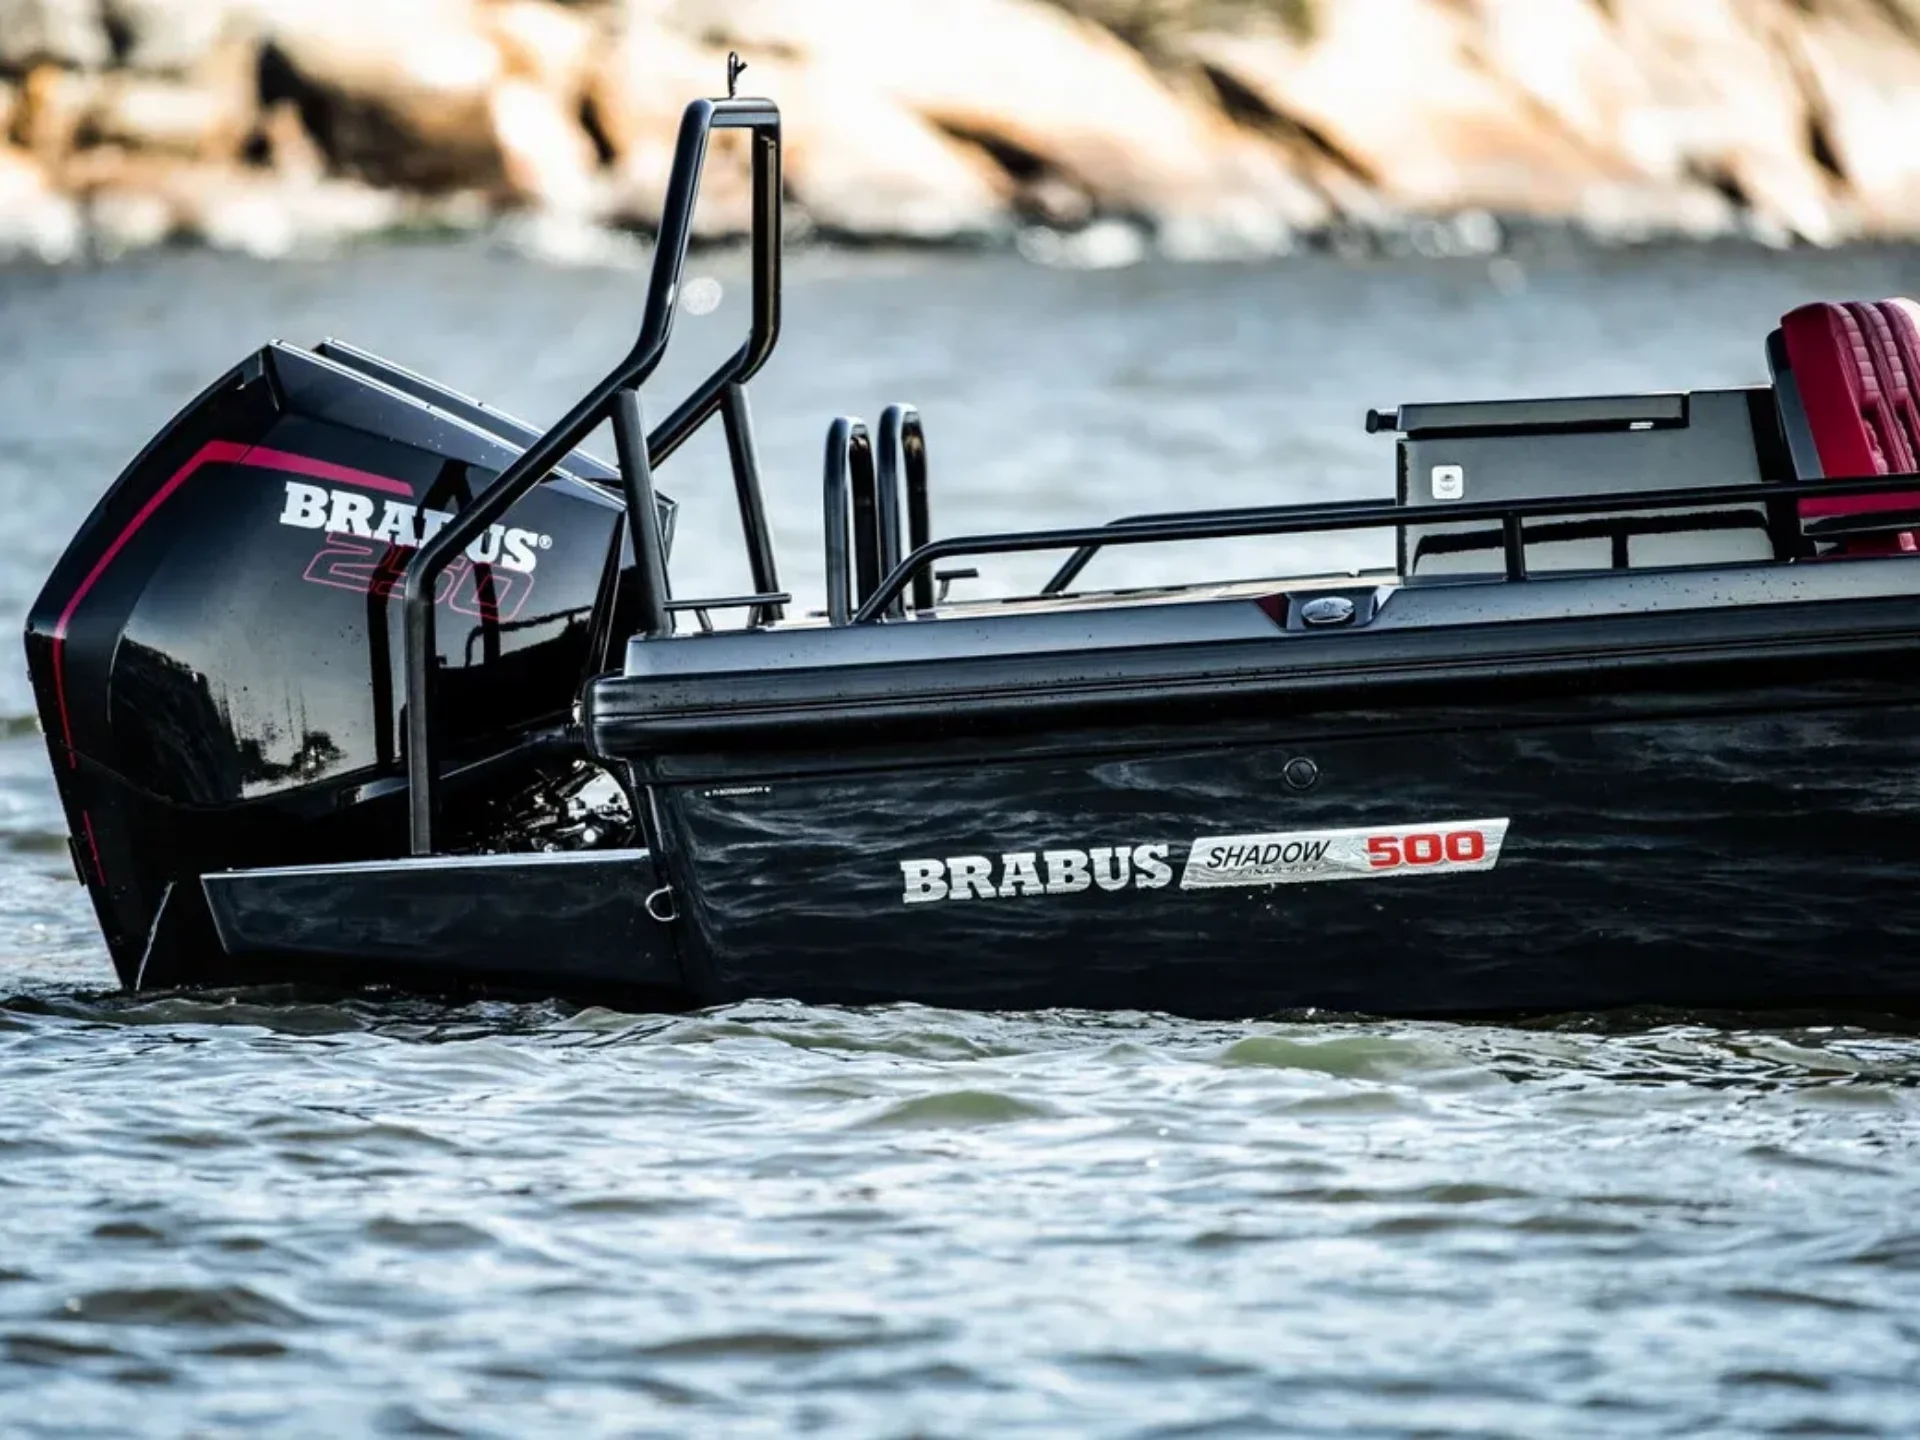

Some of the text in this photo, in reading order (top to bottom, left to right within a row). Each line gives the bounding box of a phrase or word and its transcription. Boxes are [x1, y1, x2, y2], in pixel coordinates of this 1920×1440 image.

[900, 830, 1485, 904] BRABUS SHADOW 500
